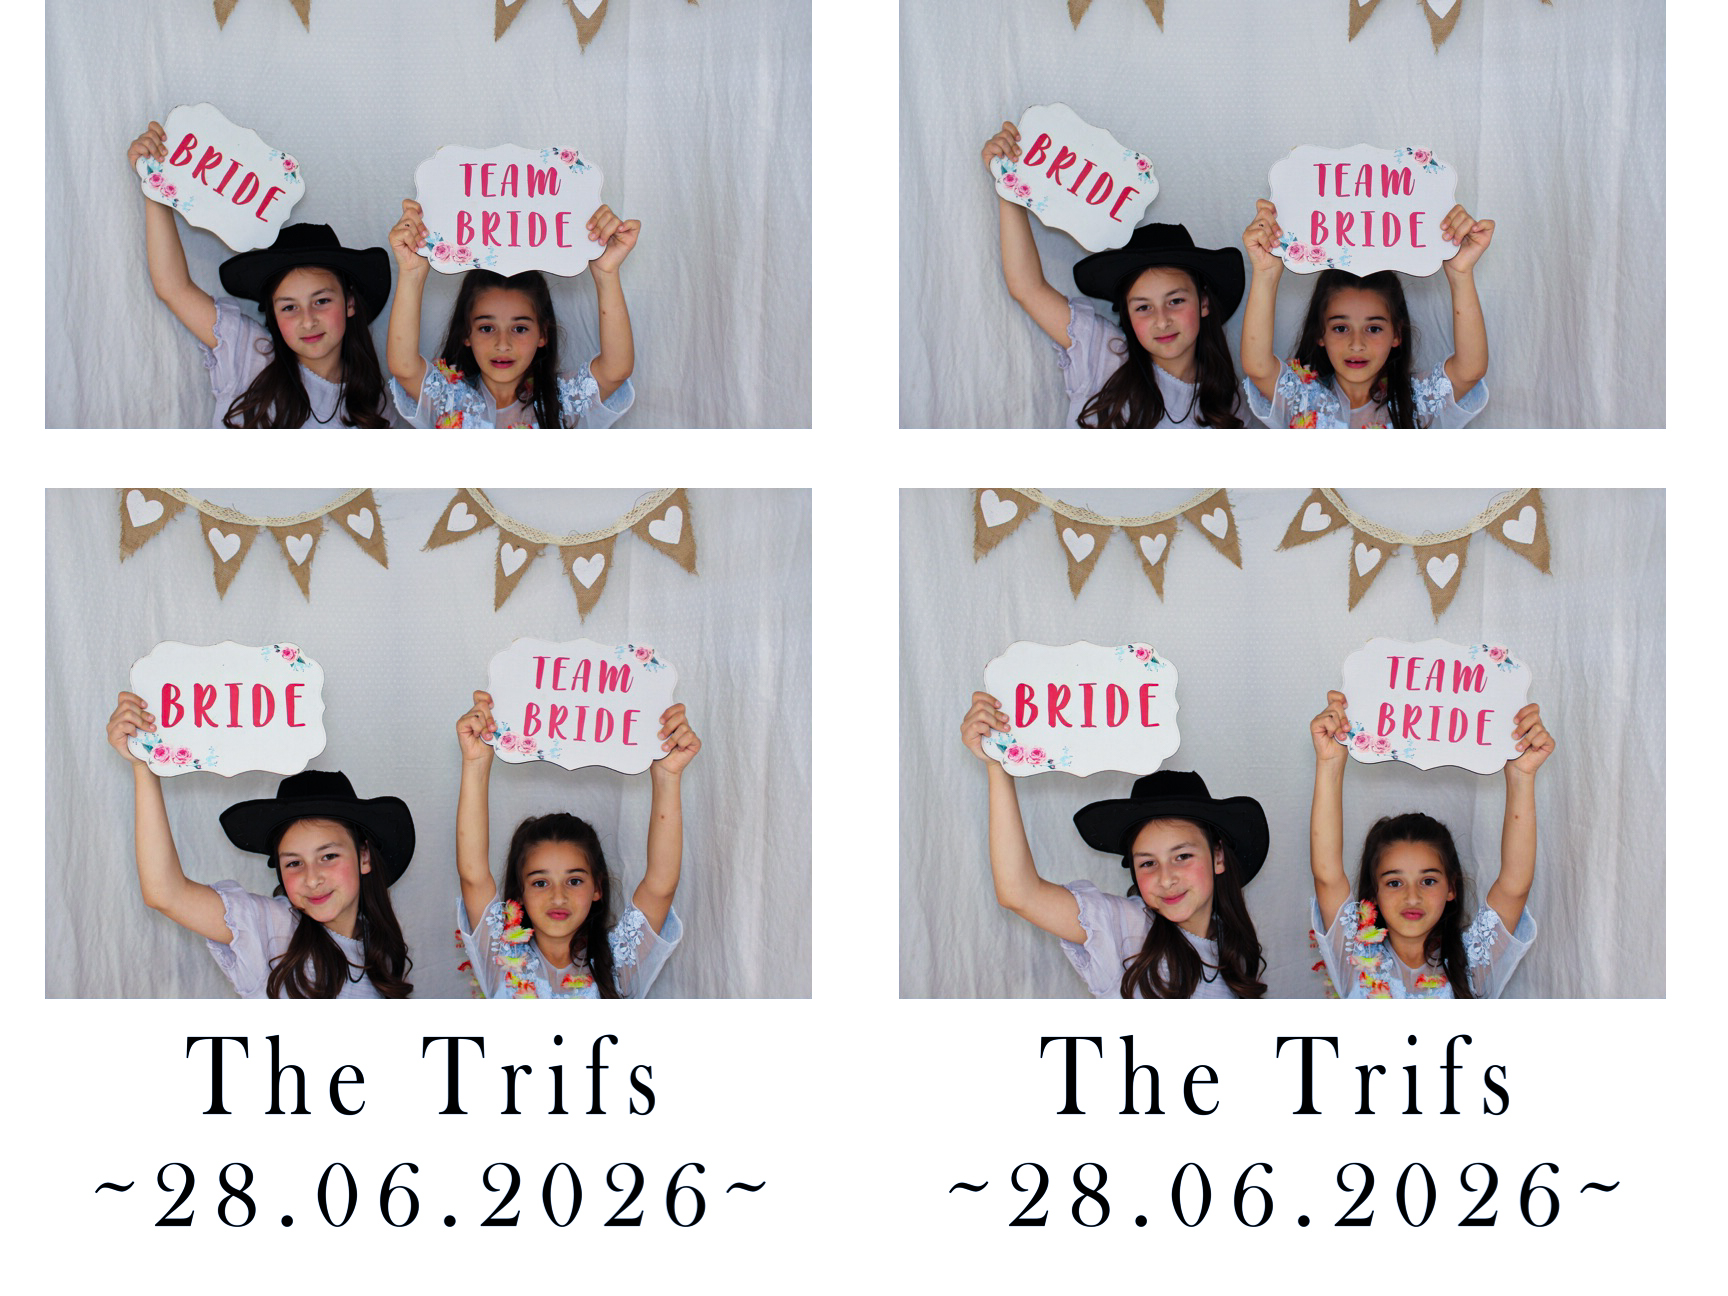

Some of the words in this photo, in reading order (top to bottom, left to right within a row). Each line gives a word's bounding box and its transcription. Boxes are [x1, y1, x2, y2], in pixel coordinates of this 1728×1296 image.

[169, 132, 288, 224] BRIDE
[459, 162, 562, 199] TEAM
[1023, 132, 1142, 224] BRIDE
[1313, 162, 1416, 199] TEAM
[456, 209, 573, 249] BRIDE
[1310, 209, 1427, 249] BRIDE
[532, 655, 634, 695] TEAM
[1386, 655, 1488, 695] TEAM
[161, 682, 307, 730] BRIDE
[522, 702, 641, 748] BRIDE
[1015, 682, 1161, 730] BRIDE
[1376, 702, 1495, 748] BRIDE
